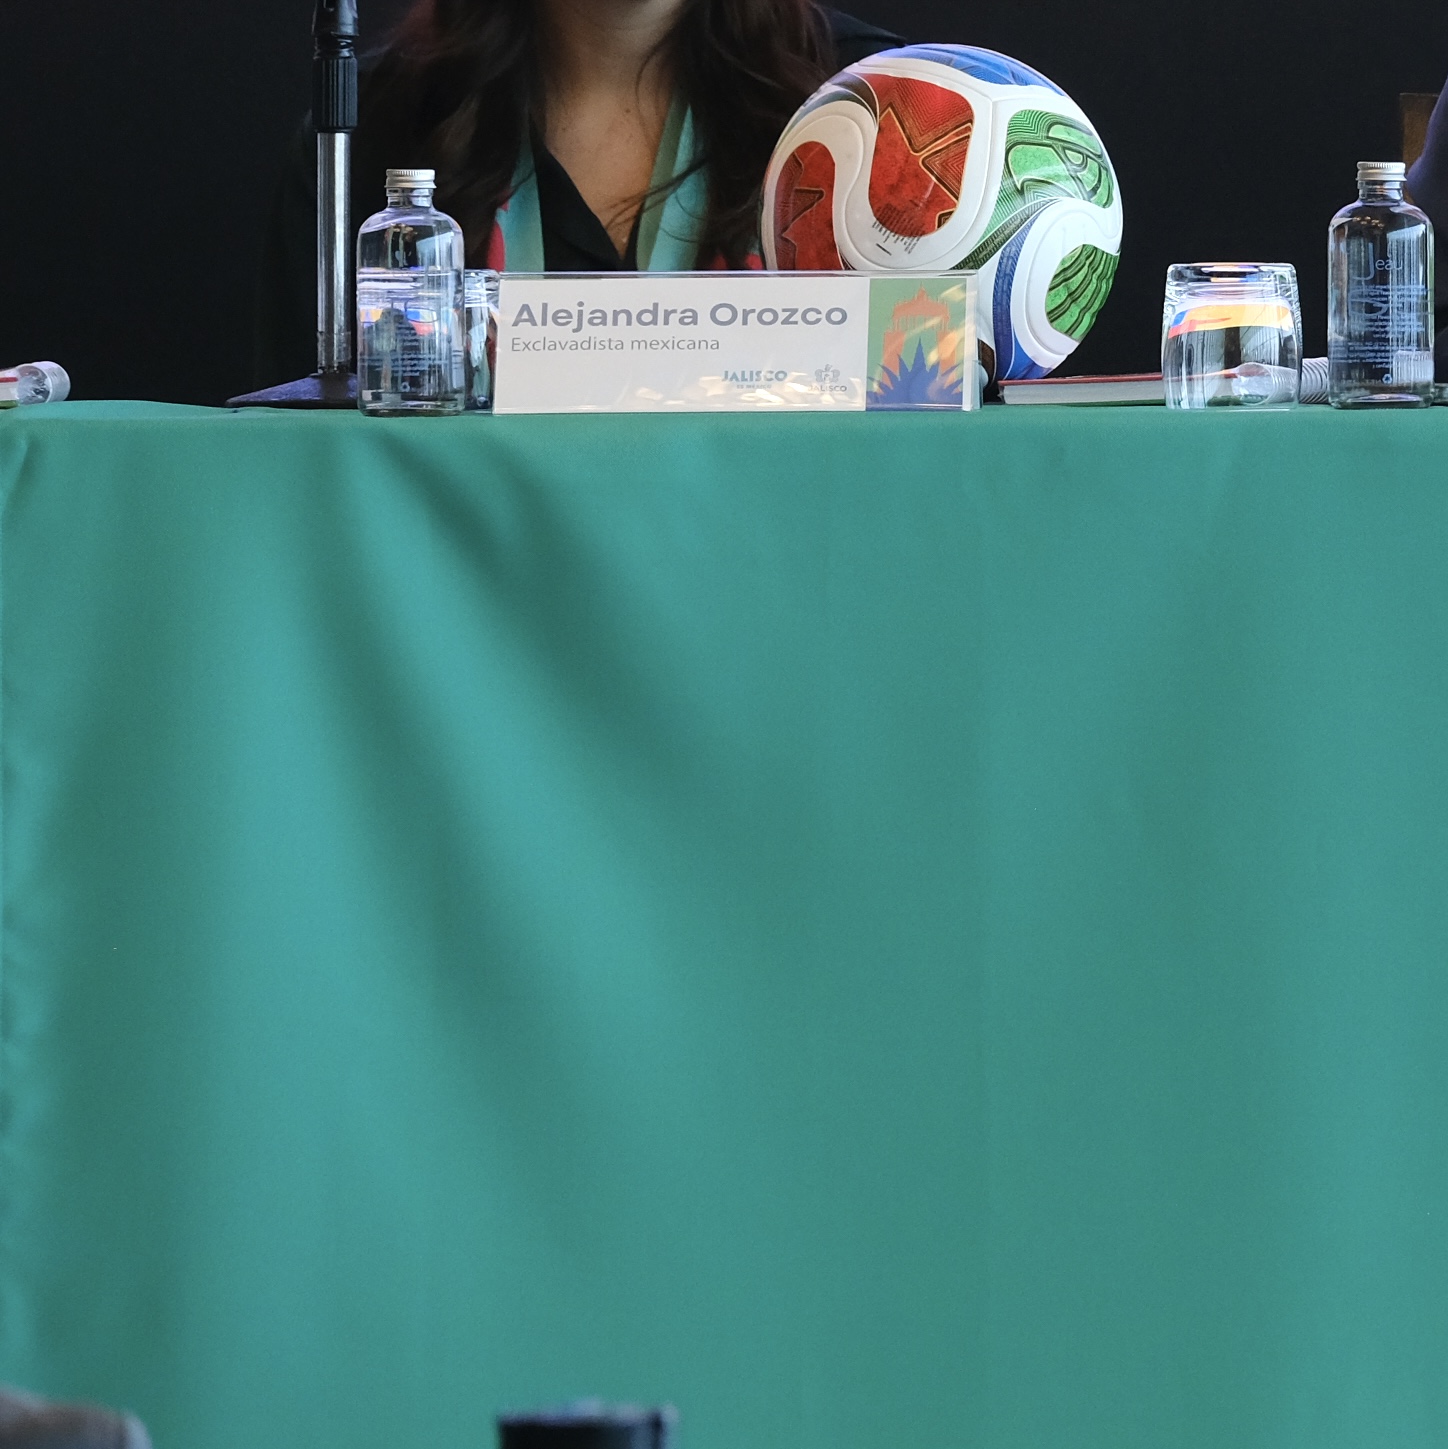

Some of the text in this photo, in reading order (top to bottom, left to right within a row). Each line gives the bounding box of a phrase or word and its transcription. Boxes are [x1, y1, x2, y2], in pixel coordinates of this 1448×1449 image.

[512, 301, 848, 334] Alejandra Orozco
[511, 335, 720, 352] Exclavadista mexicana
[721, 370, 788, 382] JALISCO
